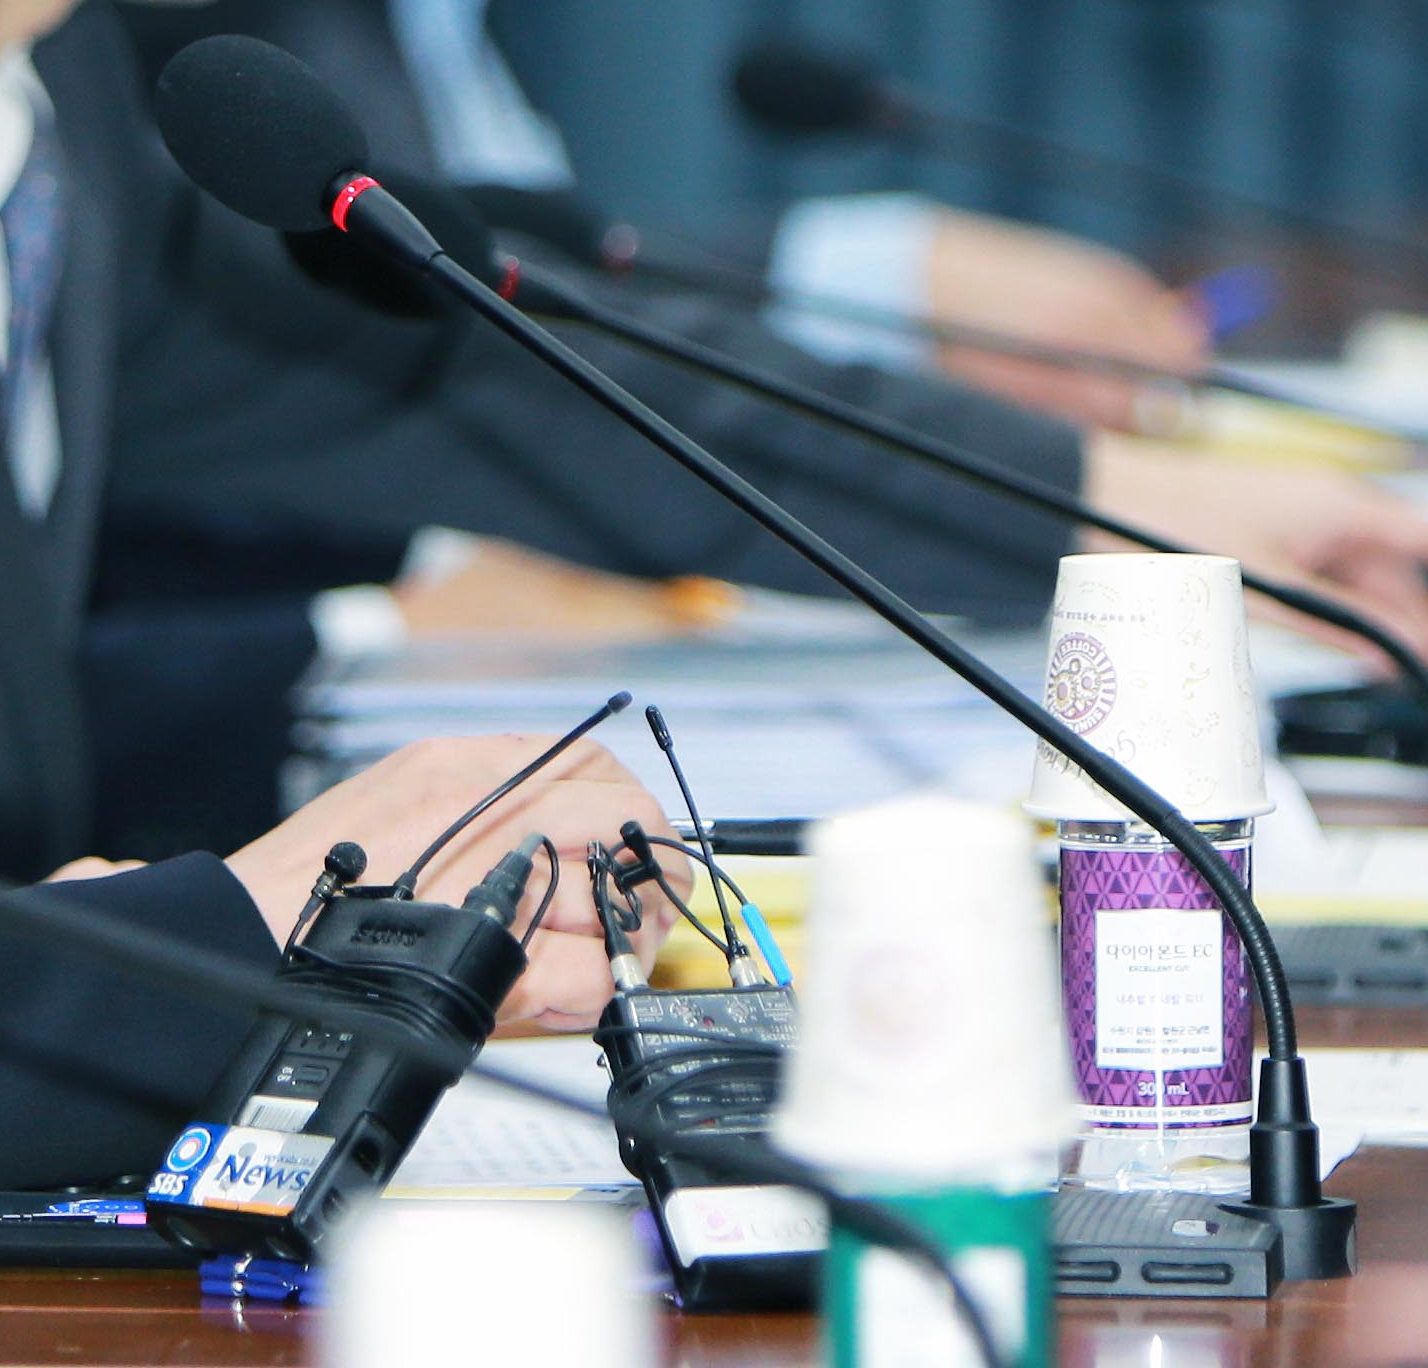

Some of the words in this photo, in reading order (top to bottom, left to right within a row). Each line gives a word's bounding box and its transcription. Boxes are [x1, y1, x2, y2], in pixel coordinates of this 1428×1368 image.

[1192, 943, 1214, 958] EC
[282, 1066, 295, 1074] ON
[276, 1074, 292, 1082] OFF
[1167, 1081, 1191, 1097] mL
[214, 1153, 311, 1192] News
[148, 1172, 190, 1196] SBS
